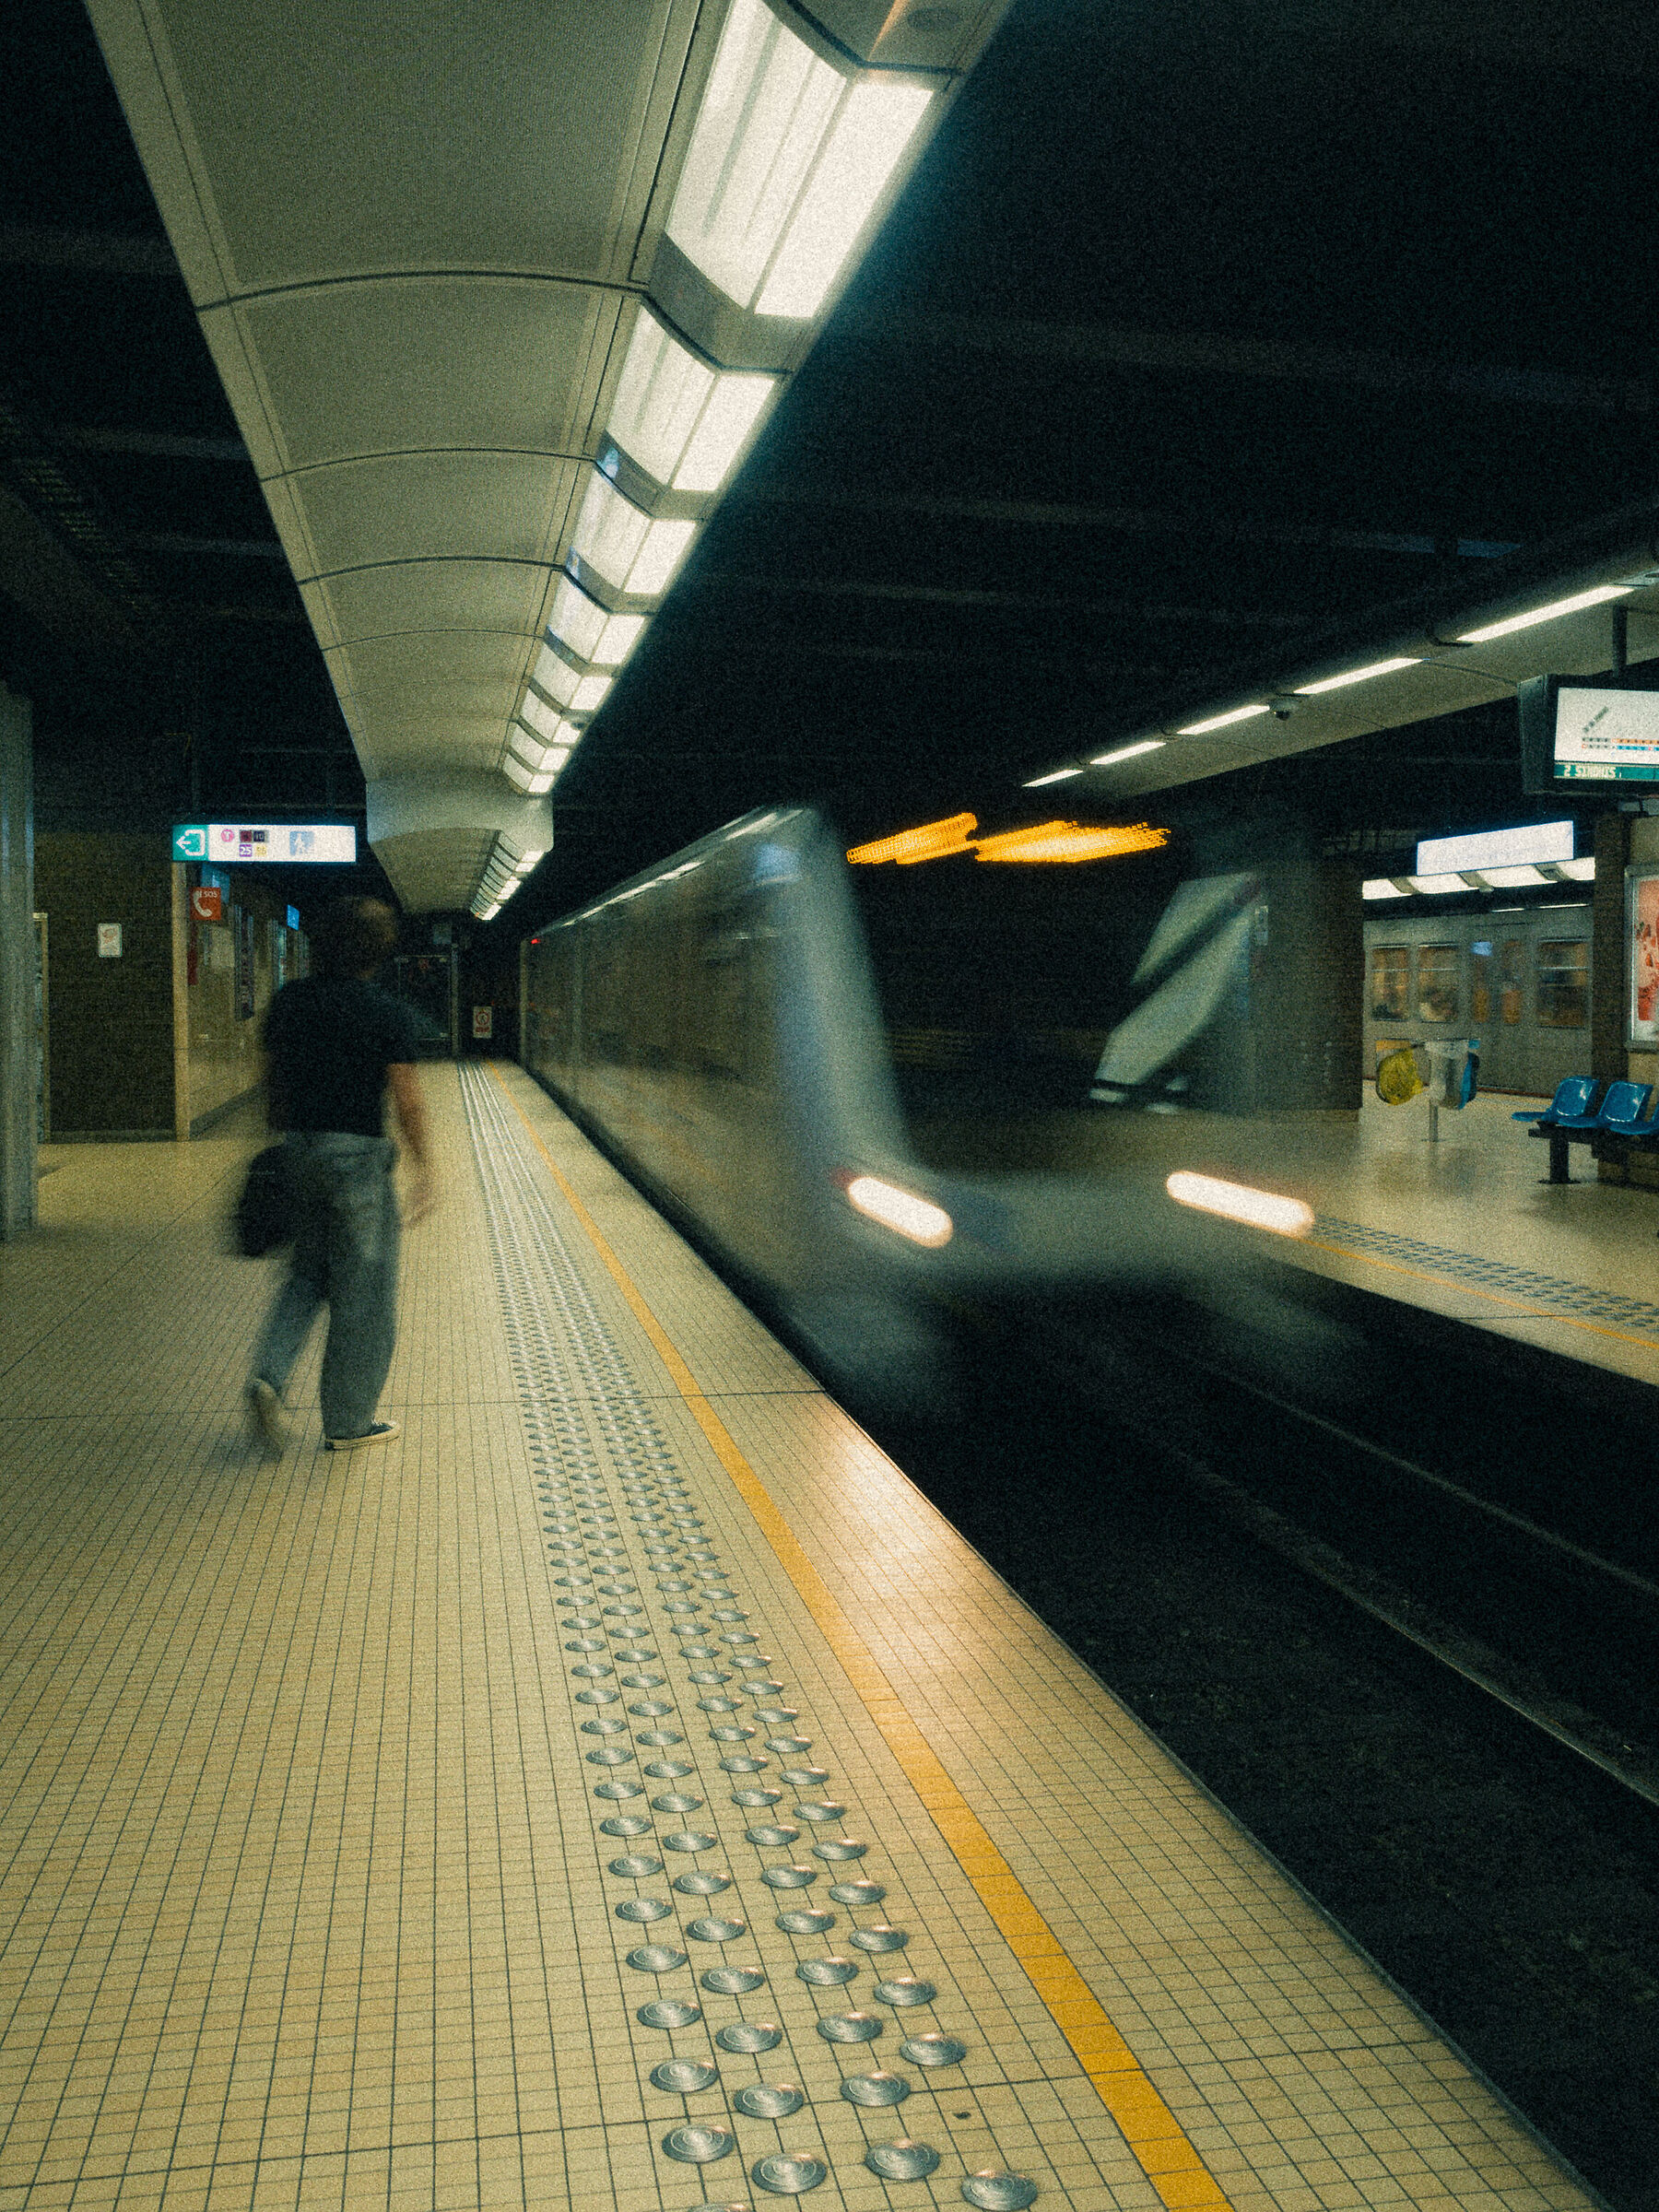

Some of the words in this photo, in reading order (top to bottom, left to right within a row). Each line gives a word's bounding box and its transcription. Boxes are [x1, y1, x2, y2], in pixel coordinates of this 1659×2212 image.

[1563, 764, 1571, 777] 2
[240, 846, 252, 855] 25
[204, 890, 218, 899] SOS
